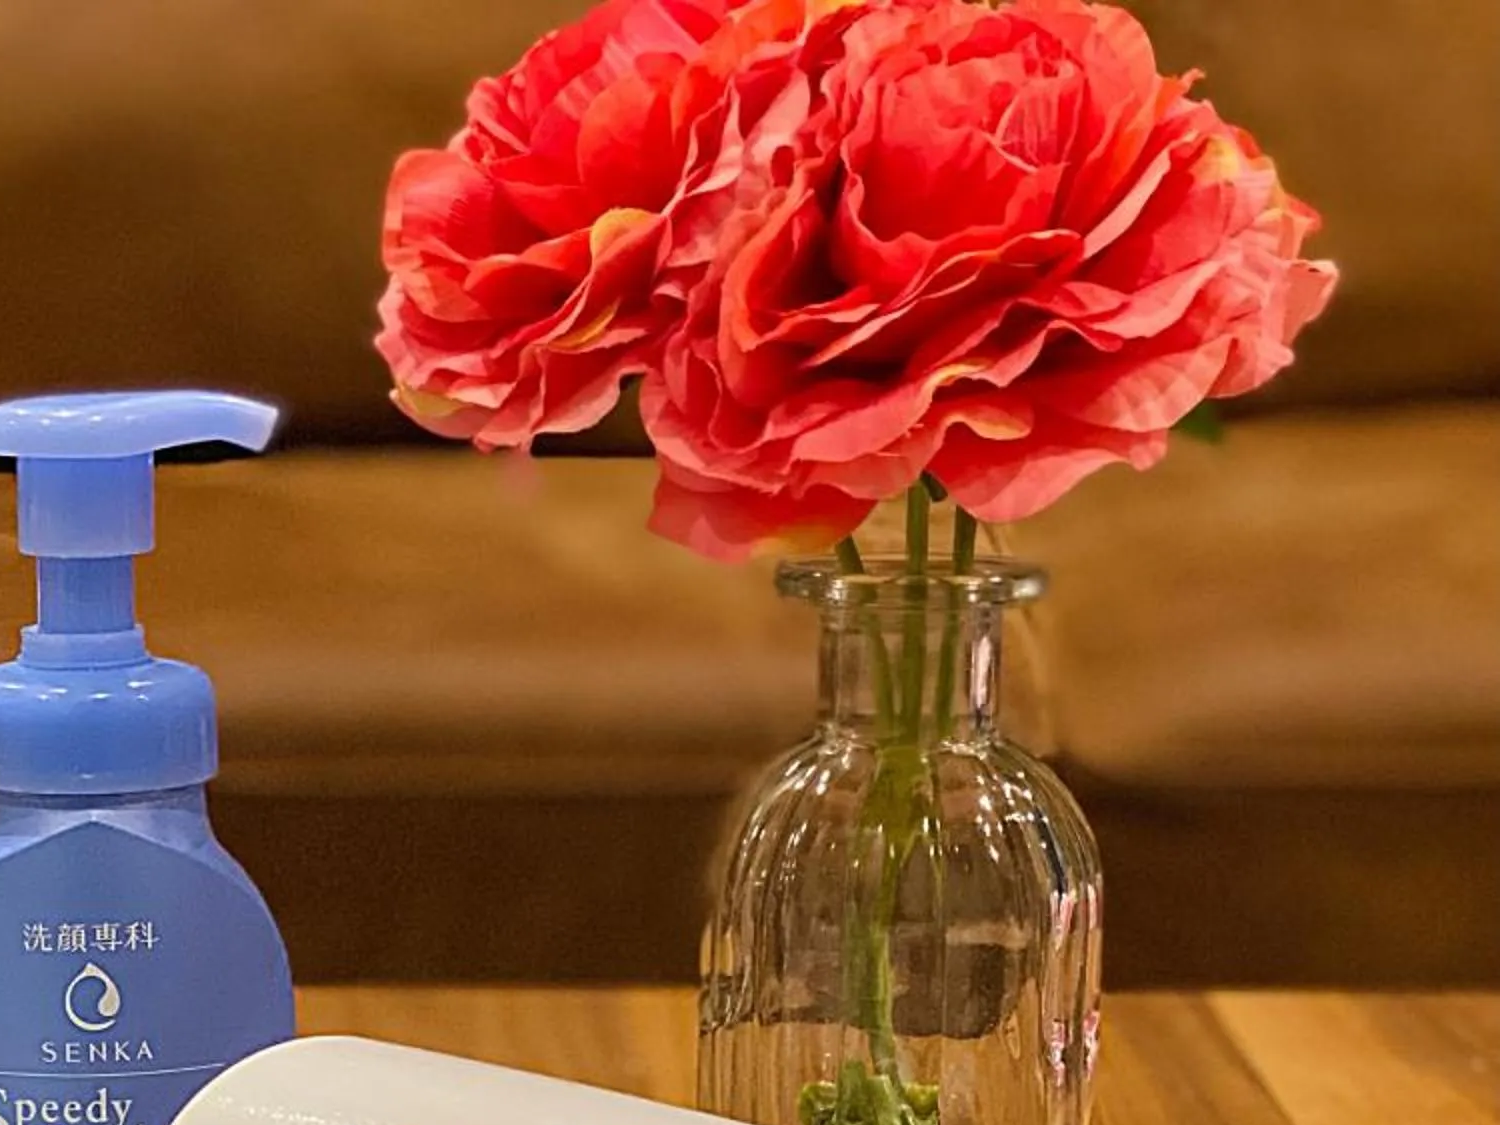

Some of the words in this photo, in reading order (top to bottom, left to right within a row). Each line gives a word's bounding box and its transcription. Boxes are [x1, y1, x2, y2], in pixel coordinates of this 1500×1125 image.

[22, 921, 161, 953] 洗顔専科
[40, 1040, 155, 1064] SENKA
